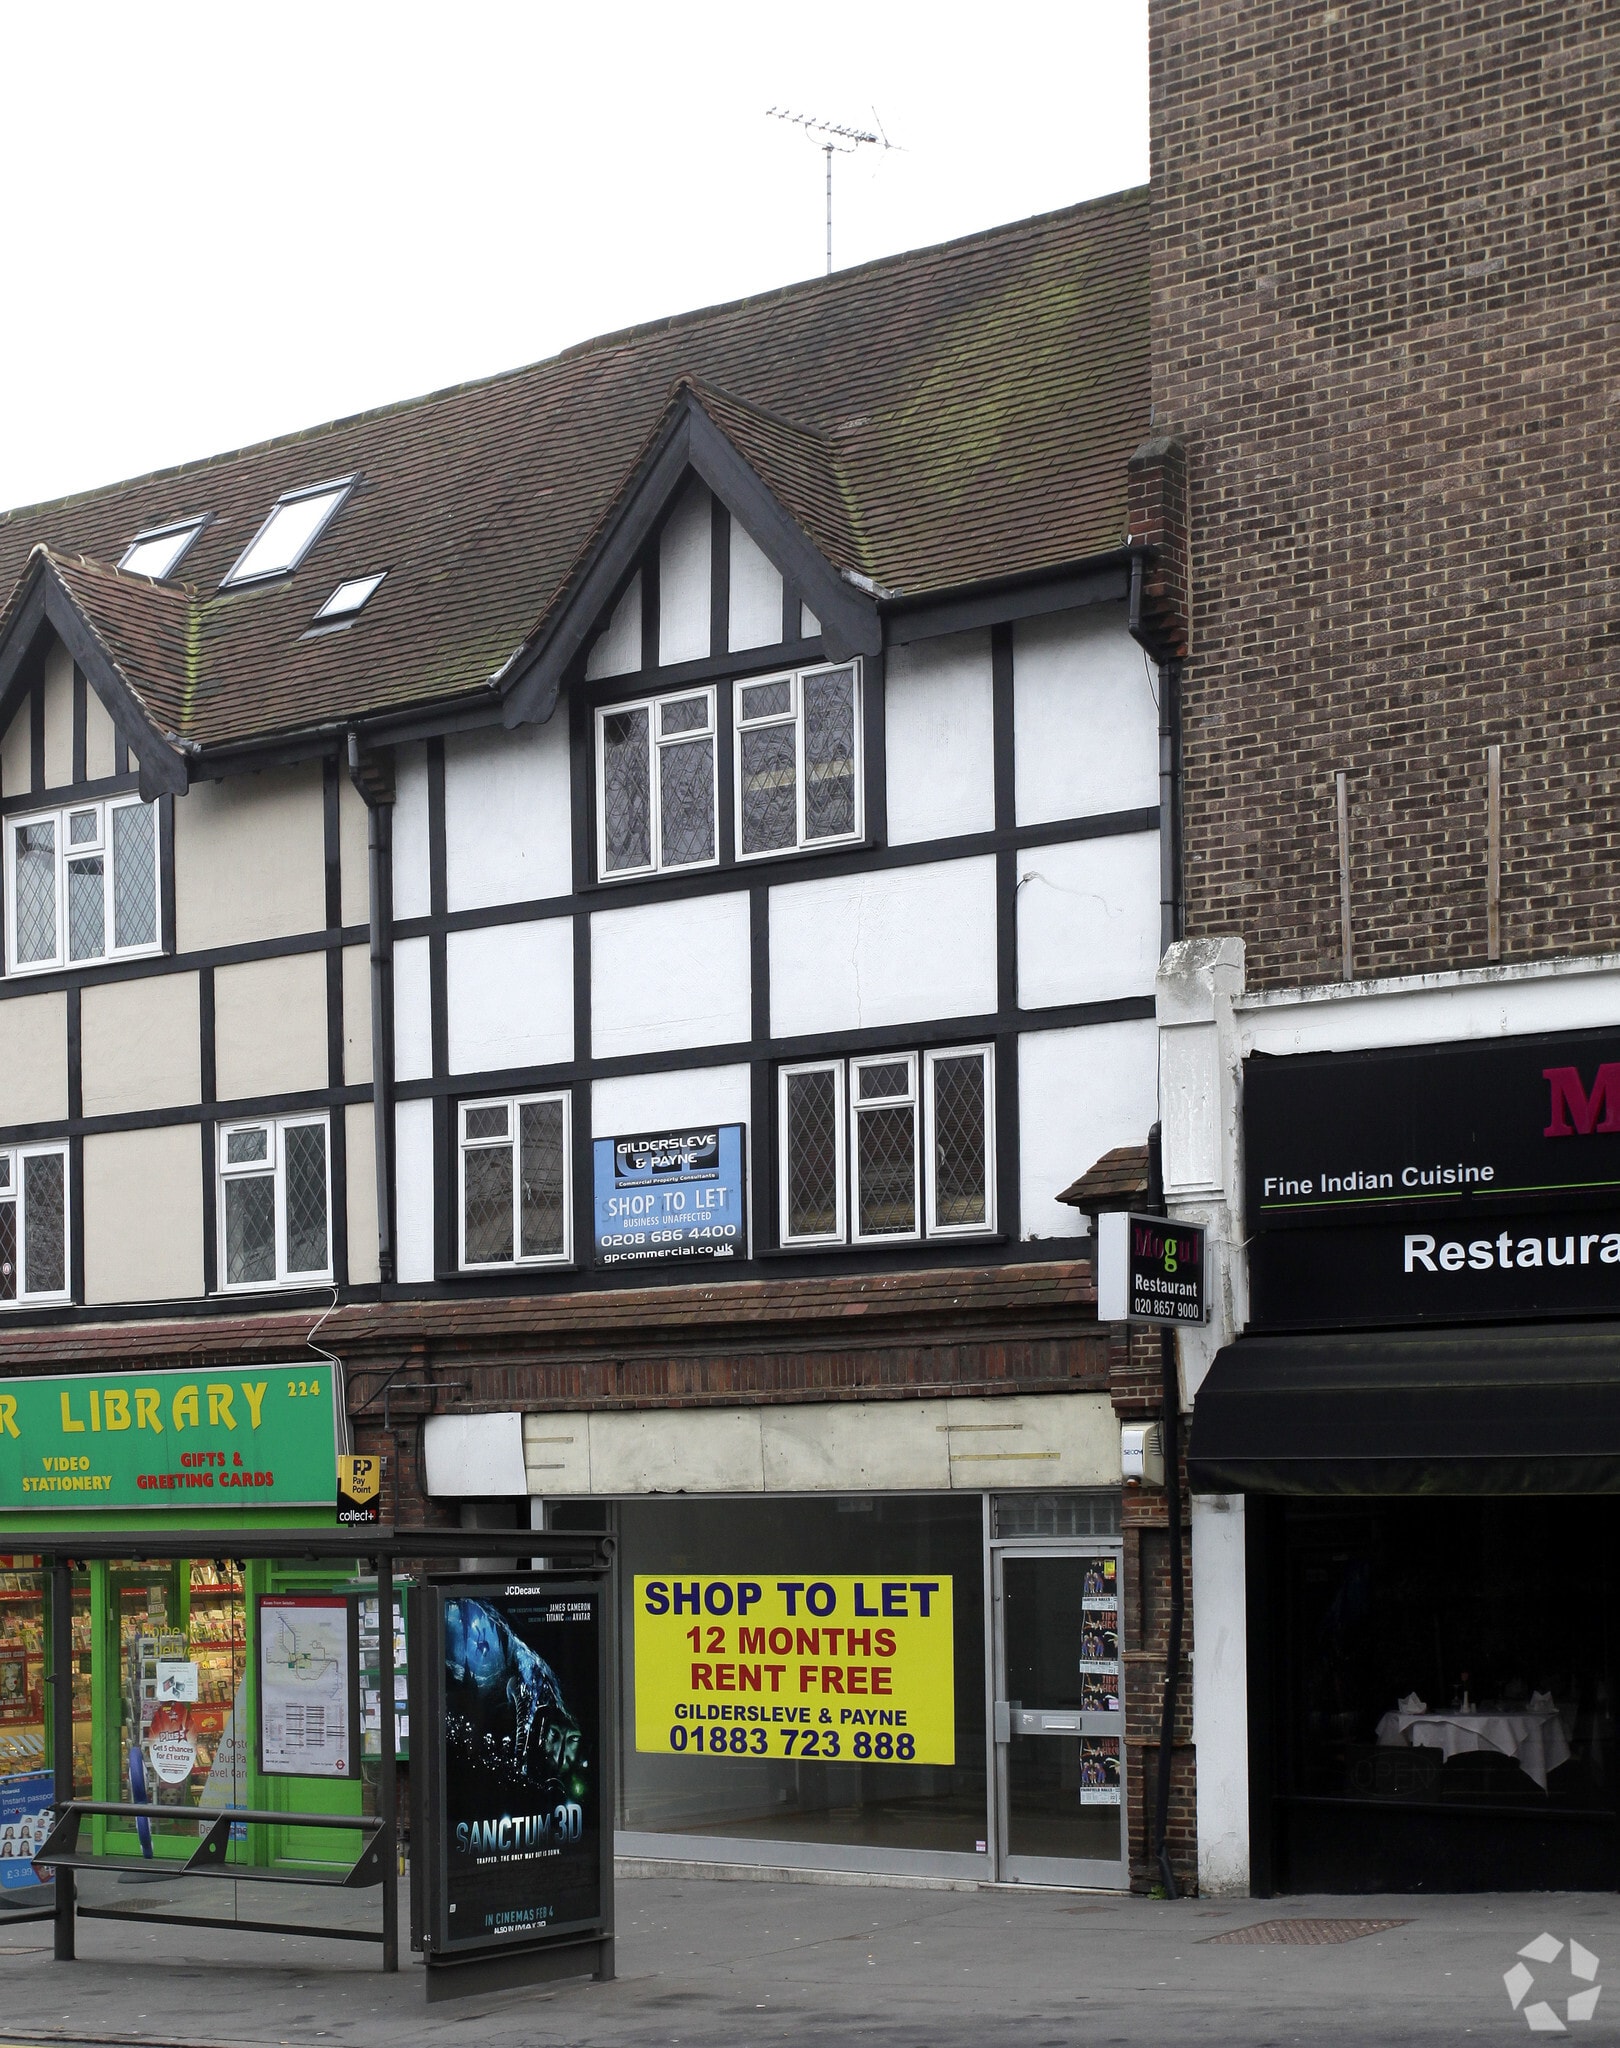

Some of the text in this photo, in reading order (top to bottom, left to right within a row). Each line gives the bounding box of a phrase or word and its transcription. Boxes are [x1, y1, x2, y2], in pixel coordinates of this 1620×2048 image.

[616, 1134, 717, 1154] GILDERSLEVE
[635, 1152, 698, 1169] & PAYNE
[618, 1173, 716, 1187] Commercial Property Consultants
[1263, 1163, 1495, 1197] Fine Indian Cuisine
[608, 1187, 727, 1217] SHOP TO LET
[623, 1212, 712, 1228] BUSINESS UNAFFECTED
[601, 1224, 736, 1247] 0208 686 4400
[603, 1243, 734, 1263] gpcommercial.co.uk
[1135, 1228, 1199, 1273] Mogul
[1403, 1231, 1620, 1274] Restaura
[1135, 1273, 1198, 1298] Restaurant
[1134, 1298, 1199, 1318] 020 8657 9000
[287, 1380, 321, 1398] 224
[0, 1381, 269, 1439] R LIBRARY
[42, 1455, 90, 1473] VIDEO
[180, 1451, 243, 1469] GIFTS &
[22, 1475, 113, 1492] STATIONERY
[137, 1471, 274, 1489] GREETING CARDS
[352, 1477, 365, 1487] Pay
[352, 1486, 371, 1494] Point
[504, 1586, 541, 1596] JCDecaux
[644, 1581, 940, 1618] SHOP TO LET
[549, 1603, 566, 1612] JAMES
[567, 1602, 591, 1612] CAMERON
[546, 1613, 565, 1622] TITANIC
[572, 1612, 591, 1621] AVATAR
[141, 1624, 181, 1639] Home
[153, 1641, 210, 1661] Delivery
[686, 1626, 898, 1658] 12 MONTHS
[691, 1662, 893, 1696] RENT FREE
[674, 1703, 908, 1727] GILDERSLEVE & PAYNE
[160, 1730, 186, 1742] Plus5
[669, 1725, 916, 1761] 01883 723 888
[168, 1745, 194, 1753] chances
[219, 1753, 235, 1764] Bus
[28, 1792, 54, 1803] passpor
[456, 1802, 583, 1854] SANCTUM 3D
[476, 1856, 499, 1865] TRAPPED.
[511, 1853, 523, 1861] ONLY
[524, 1852, 534, 1860] WAY
[485, 1905, 554, 1927] IN CINEMAS FEB 4
[494, 1920, 547, 1934] ALSO IN IMAX 3D
